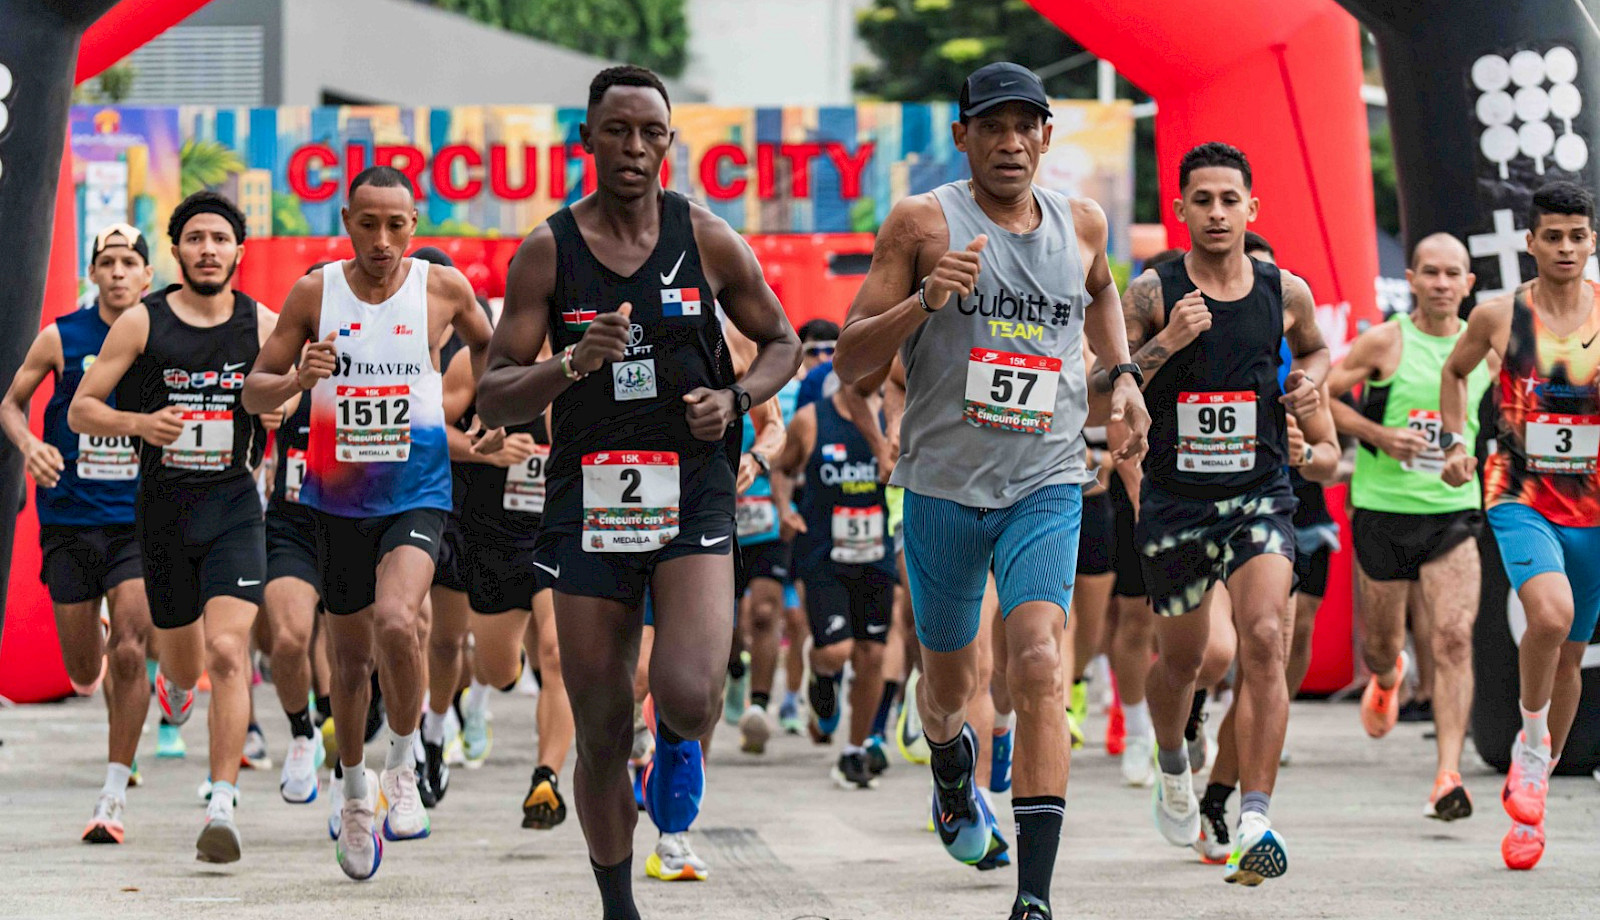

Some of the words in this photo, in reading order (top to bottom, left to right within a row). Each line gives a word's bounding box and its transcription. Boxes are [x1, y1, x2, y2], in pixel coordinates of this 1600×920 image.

[288, 143, 672, 202] CIRCUIT
[699, 142, 876, 201] CITY
[957, 286, 1048, 323] Cubitt
[988, 320, 1044, 342] TEAM
[354, 362, 421, 376] TRAVERS
[1009, 357, 1027, 366] 15K
[990, 368, 1038, 406] 57
[338, 398, 410, 426] 1512
[977, 411, 1020, 425] CIRCUITO
[1021, 416, 1041, 427] CITY
[1198, 406, 1236, 434] 96
[191, 423, 204, 447] 1
[347, 433, 383, 442] CIRCUITO
[384, 433, 401, 441] CITY
[1555, 428, 1572, 453] 3
[1190, 443, 1226, 451] CIRCUITO
[1227, 442, 1244, 450] CITY
[621, 454, 639, 463] 15K
[620, 468, 642, 503] 2
[598, 516, 643, 525] CIRCUITO
[643, 516, 665, 525] CITY
[848, 519, 870, 536] 51
[612, 536, 651, 544] MEDALLA
